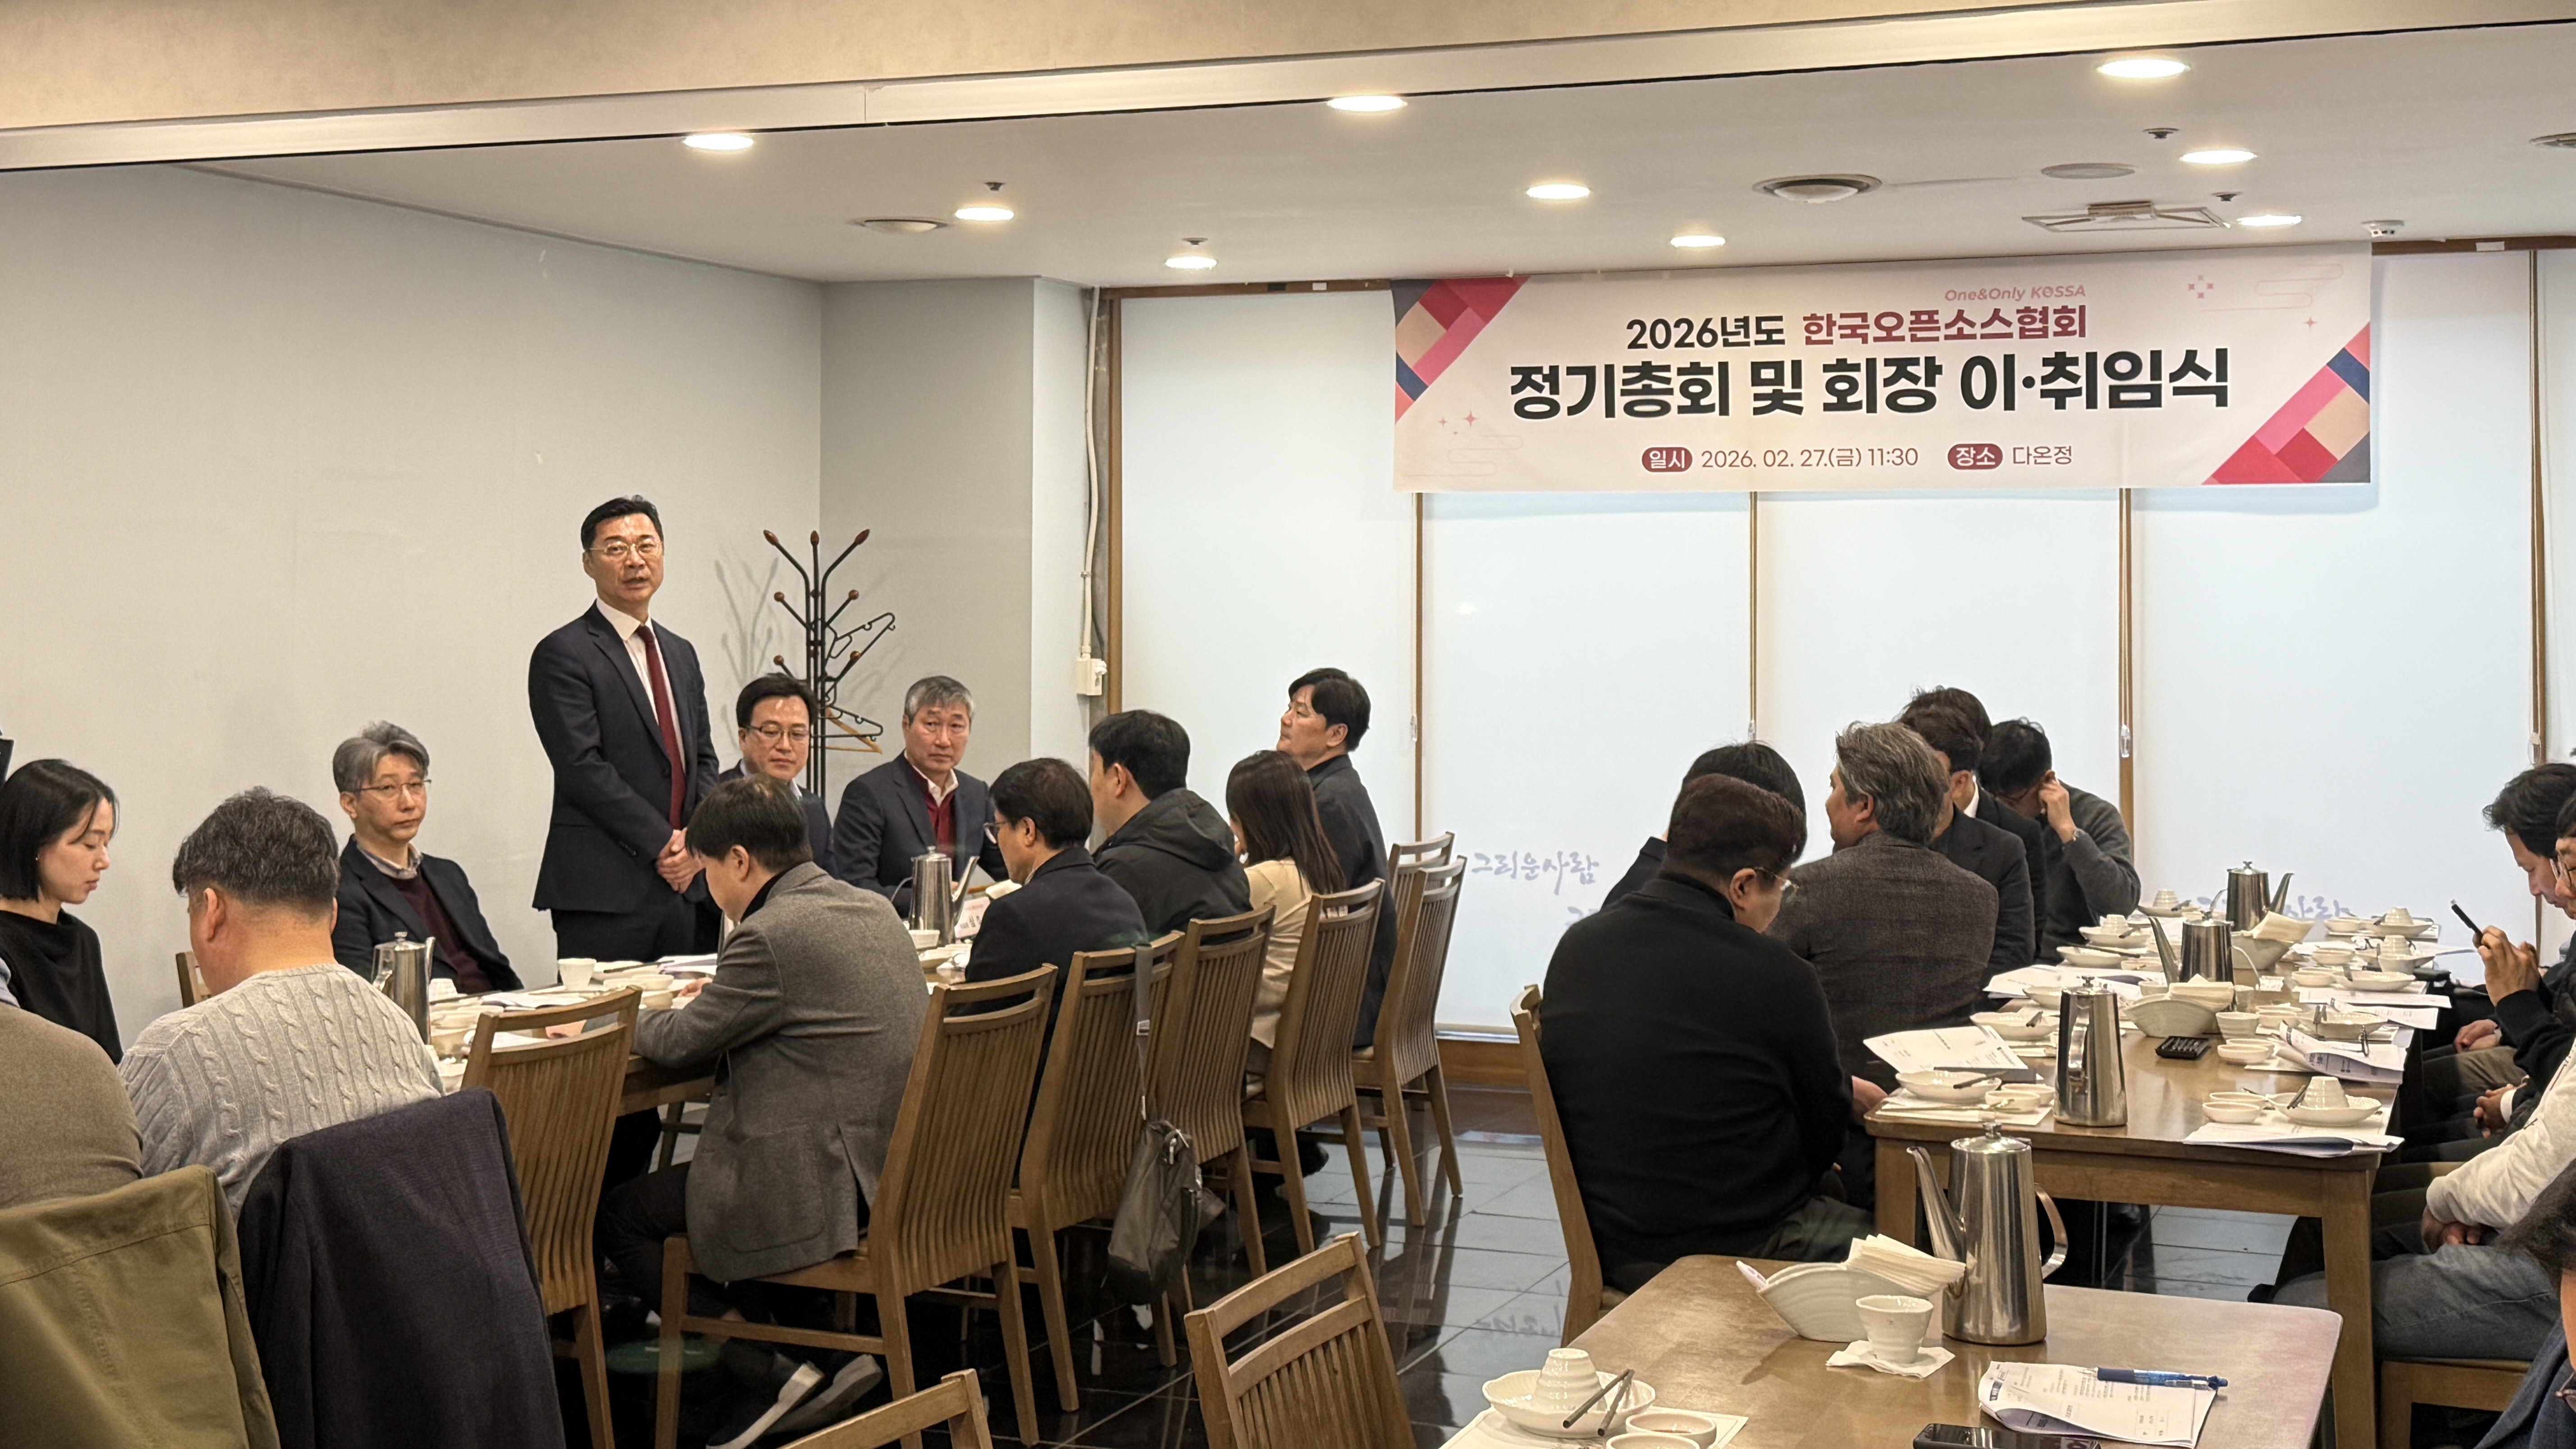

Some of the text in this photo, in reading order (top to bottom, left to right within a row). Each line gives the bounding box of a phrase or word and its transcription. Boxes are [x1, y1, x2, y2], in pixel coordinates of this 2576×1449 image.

[1945, 285, 2086, 301] One&Only KOSSA
[1626, 305, 2086, 350] 2026년도 한국오픈소스협회
[1510, 348, 2228, 419] 정기총회 및 회장 이·취임식
[1649, 446, 2072, 469] 일시 2026. 02. 27.(금) 11:30 장소 다온정
